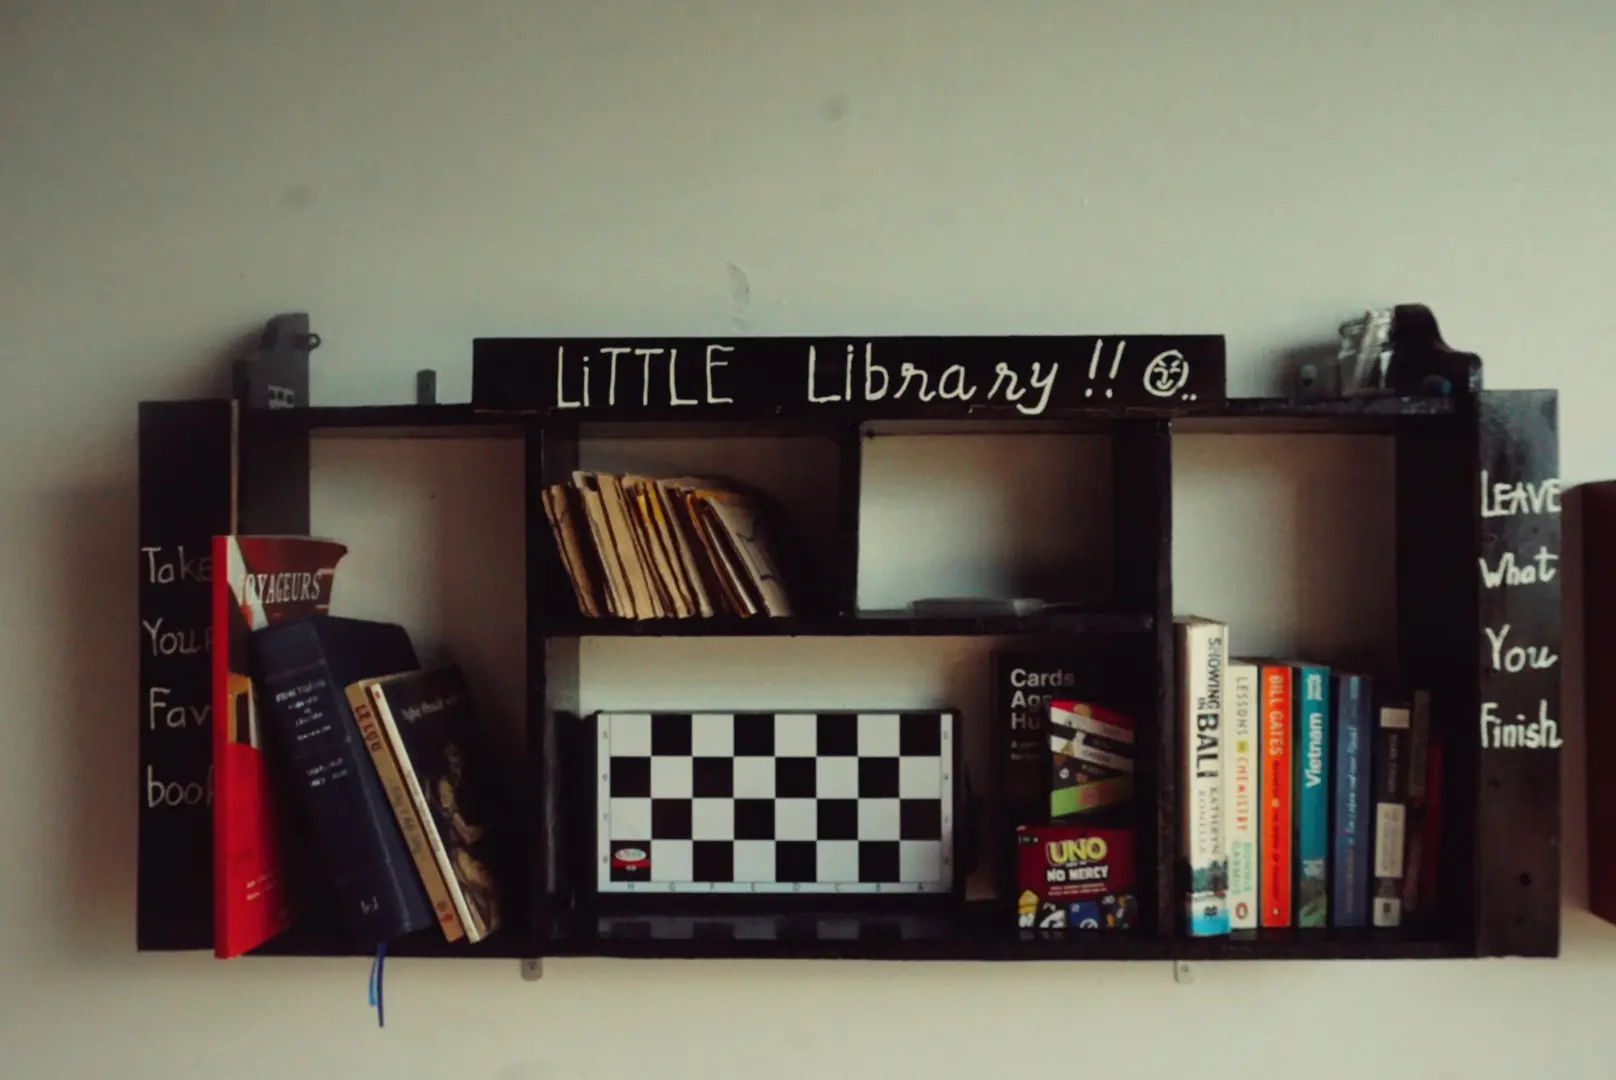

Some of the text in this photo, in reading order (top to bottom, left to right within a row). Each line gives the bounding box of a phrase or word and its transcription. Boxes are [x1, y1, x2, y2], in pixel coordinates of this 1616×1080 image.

[807, 342, 1059, 416] Library
[1480, 469, 1562, 518] LEAVE
[141, 546, 212, 585] Take
[1478, 545, 1559, 589] What
[1483, 623, 1558, 673] You
[1010, 668, 1075, 688] Cards
[1269, 674, 1284, 706] BILL
[149, 688, 212, 731] Fav
[1235, 676, 1249, 736] LESSONS
[1479, 699, 1564, 749] Finish
[1196, 712, 1219, 779] BALI
[1269, 710, 1284, 757] GATES
[1304, 711, 1323, 789] Vietnam
[1046, 836, 1108, 866] UNO
[1046, 864, 1110, 883] NO MERCY
